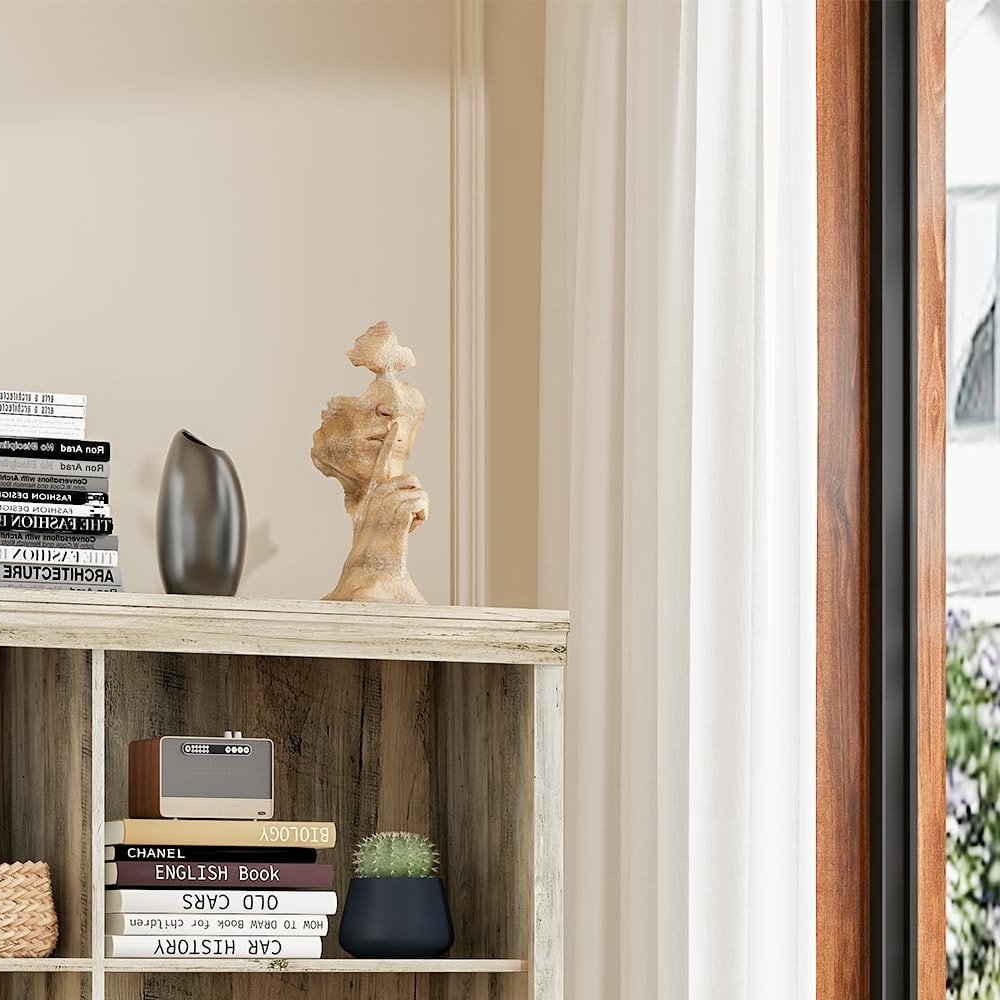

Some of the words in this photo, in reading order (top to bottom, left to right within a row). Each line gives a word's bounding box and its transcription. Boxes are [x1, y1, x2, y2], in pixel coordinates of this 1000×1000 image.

[259, 826, 329, 842] BIOLOGY
[127, 848, 185, 859] CHANEL
[156, 865, 228, 881] ENGLISH
[240, 866, 280, 881] Book
[183, 894, 229, 909] CARS
[243, 894, 279, 911] OLD
[129, 918, 184, 928] children
[192, 919, 210, 928] for
[218, 919, 244, 928] Book
[250, 920, 277, 929] DRAW
[284, 920, 296, 929] TO
[303, 920, 323, 930] HOW
[153, 939, 235, 955] HISTORY
[248, 940, 282, 955] CAR
